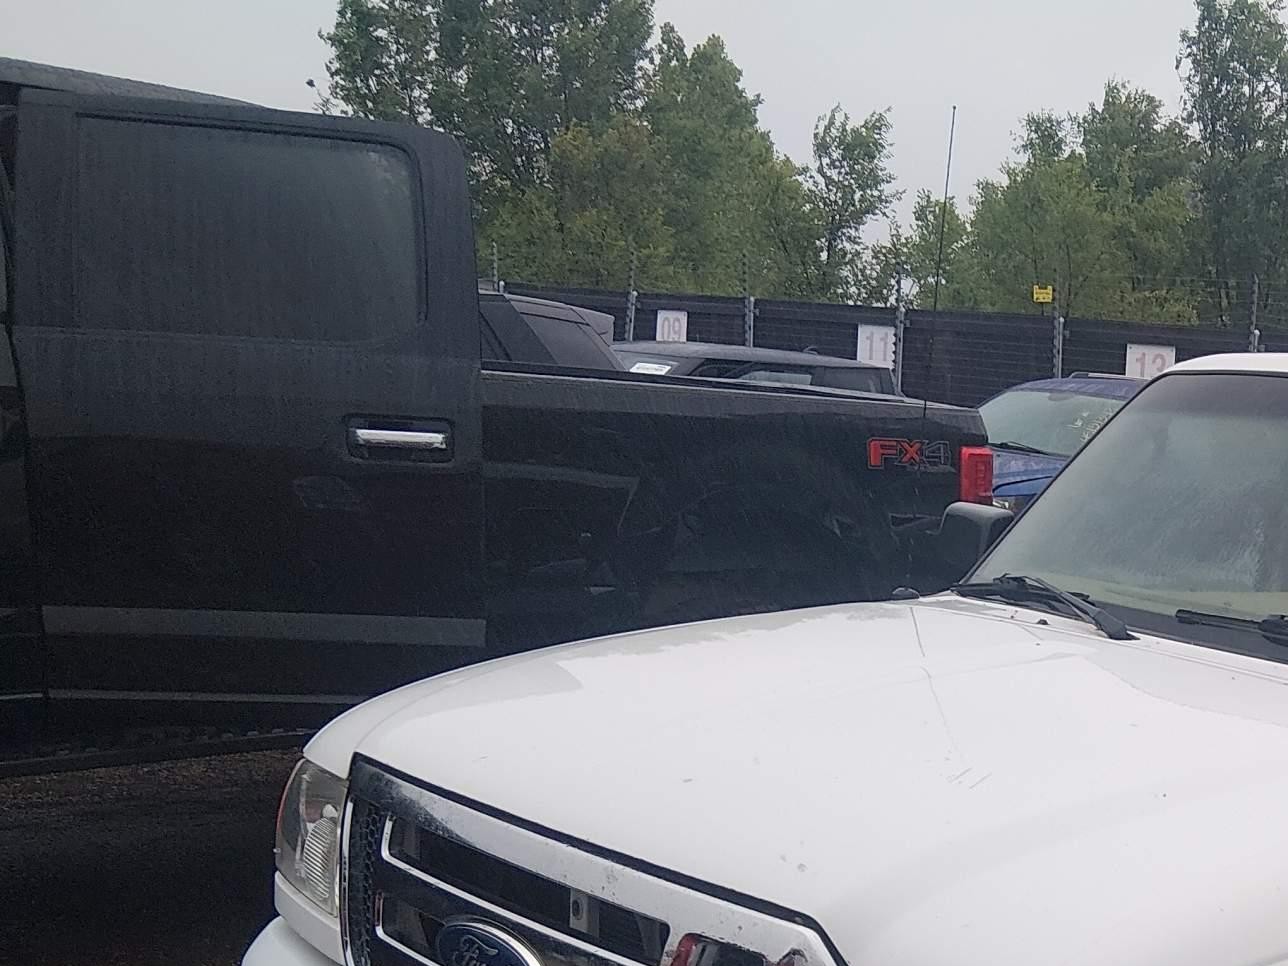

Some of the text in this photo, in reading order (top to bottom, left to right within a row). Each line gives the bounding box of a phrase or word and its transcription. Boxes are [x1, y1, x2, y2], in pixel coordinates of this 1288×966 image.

[661, 316, 682, 341] 09
[865, 331, 889, 362] 11
[868, 438, 950, 468] FX4
